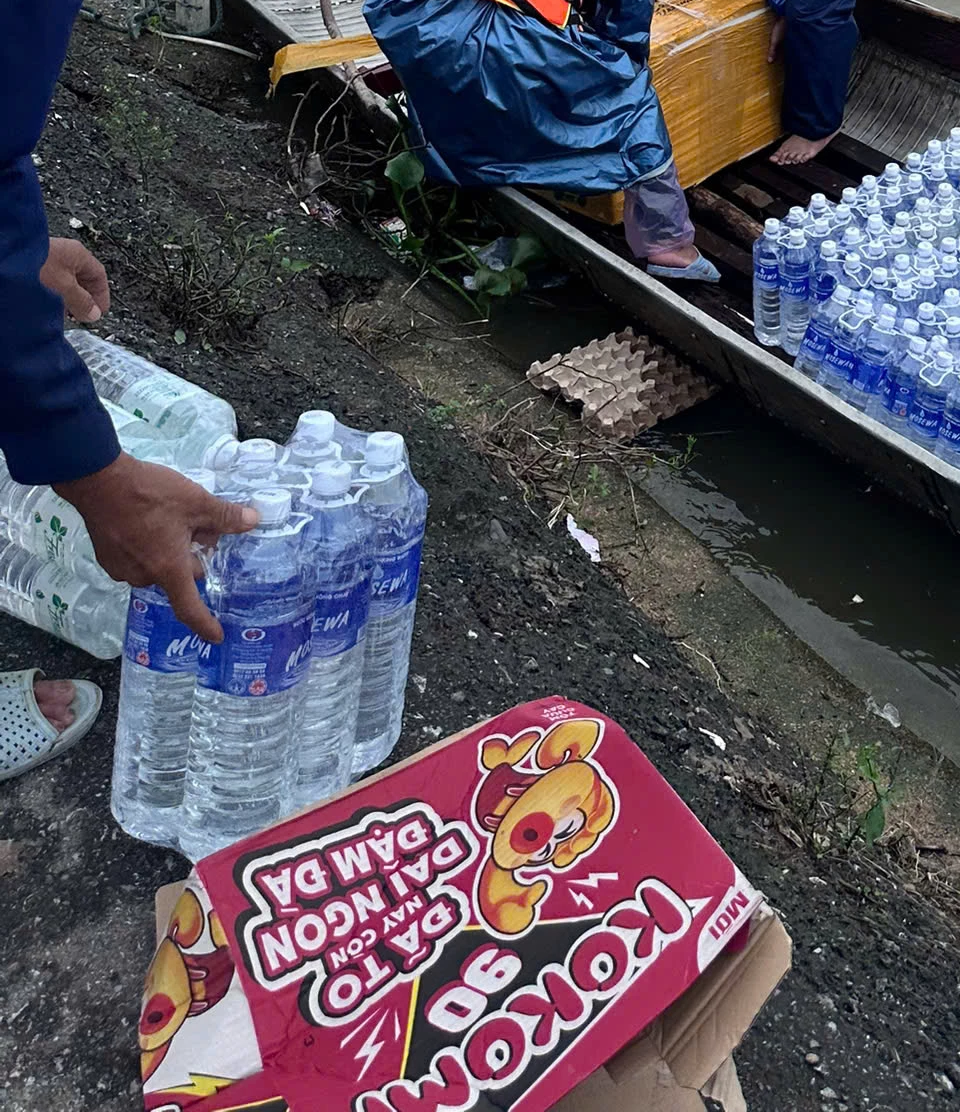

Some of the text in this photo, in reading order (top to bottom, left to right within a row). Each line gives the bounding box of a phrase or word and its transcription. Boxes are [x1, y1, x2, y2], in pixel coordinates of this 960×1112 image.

[261, 819, 429, 913] ĐẬM ĐÀ
[260, 883, 387, 971] NGON
[328, 901, 454, 1009] ĐÃ TO
[329, 895, 425, 969] NAY CÒN
[424, 942, 523, 1033] 90
